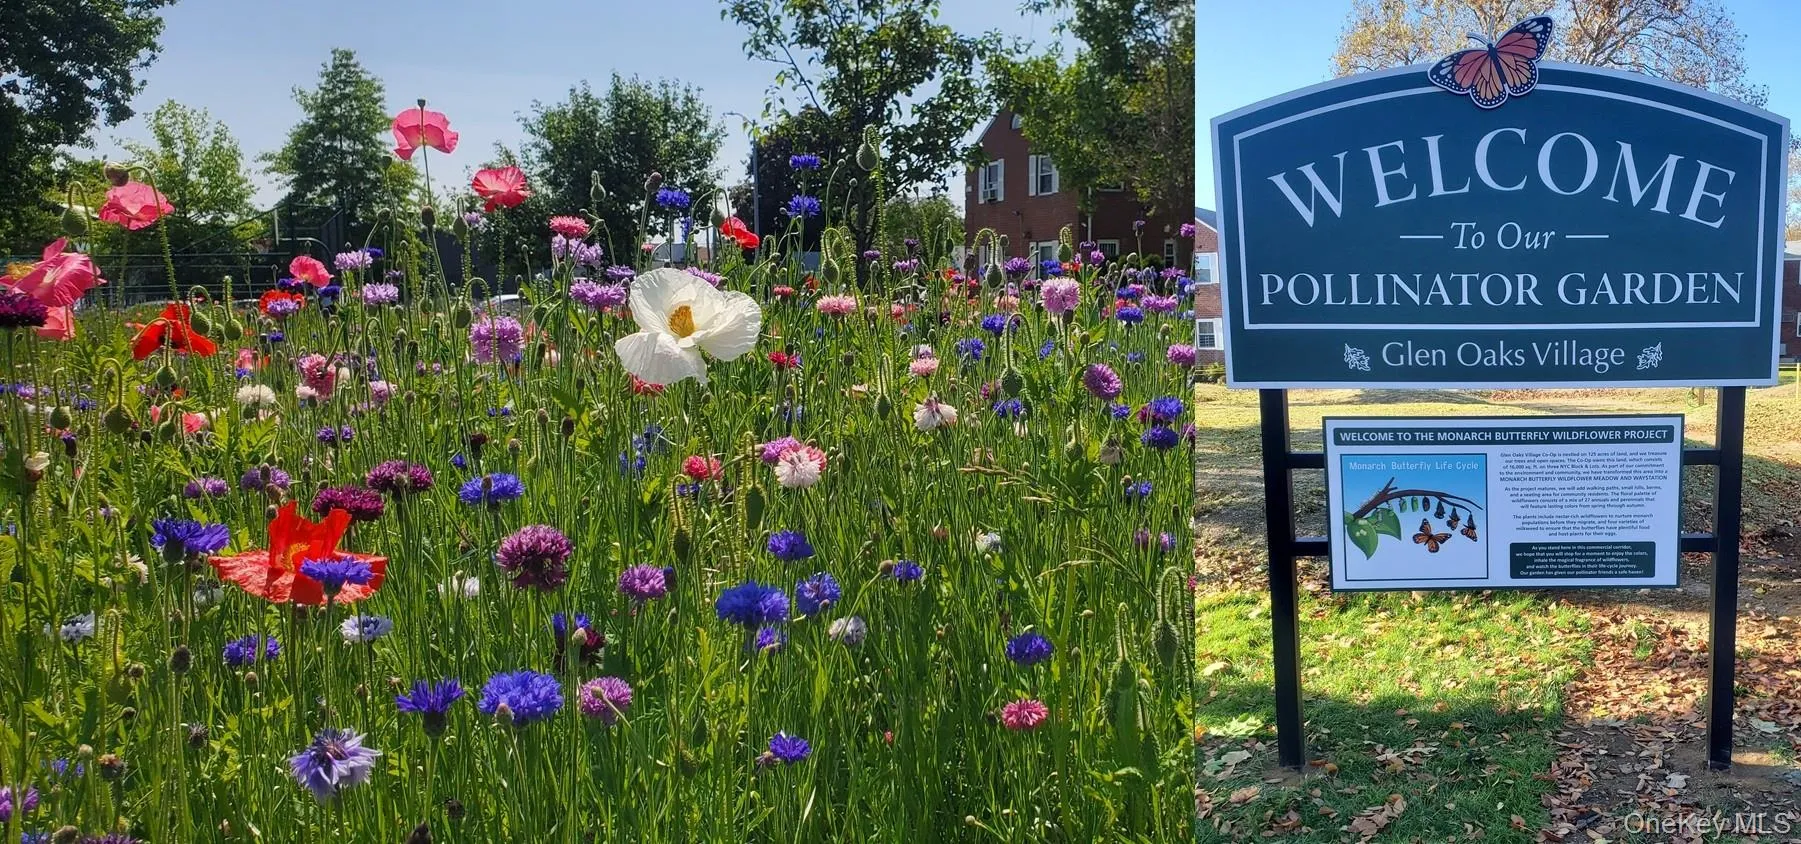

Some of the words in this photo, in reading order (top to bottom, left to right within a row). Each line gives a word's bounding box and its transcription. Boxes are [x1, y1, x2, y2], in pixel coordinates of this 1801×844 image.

[1267, 127, 1736, 229] WELCOME
[1450, 222, 1485, 250] To
[1497, 222, 1555, 250] Our
[1259, 272, 1544, 307] POLLINATOR
[1557, 271, 1744, 306] GARDEN
[1382, 341, 1447, 368] Glen
[1457, 341, 1525, 368] Oaks
[1532, 341, 1625, 374] Village
[1340, 432, 1396, 442] WELCOME
[1399, 432, 1411, 441] TO
[1414, 432, 1434, 441] THE
[1437, 432, 1492, 441] MONARCH
[1495, 431, 1549, 440] BUTTERFLY
[1553, 430, 1621, 440] WILDFLOWER
[1624, 430, 1667, 439] PROJECT
[1350, 462, 1386, 471] Monarch
[1391, 462, 1431, 472] Butterfly
[1435, 462, 1452, 470] Life
[1456, 462, 1478, 471] Cycle
